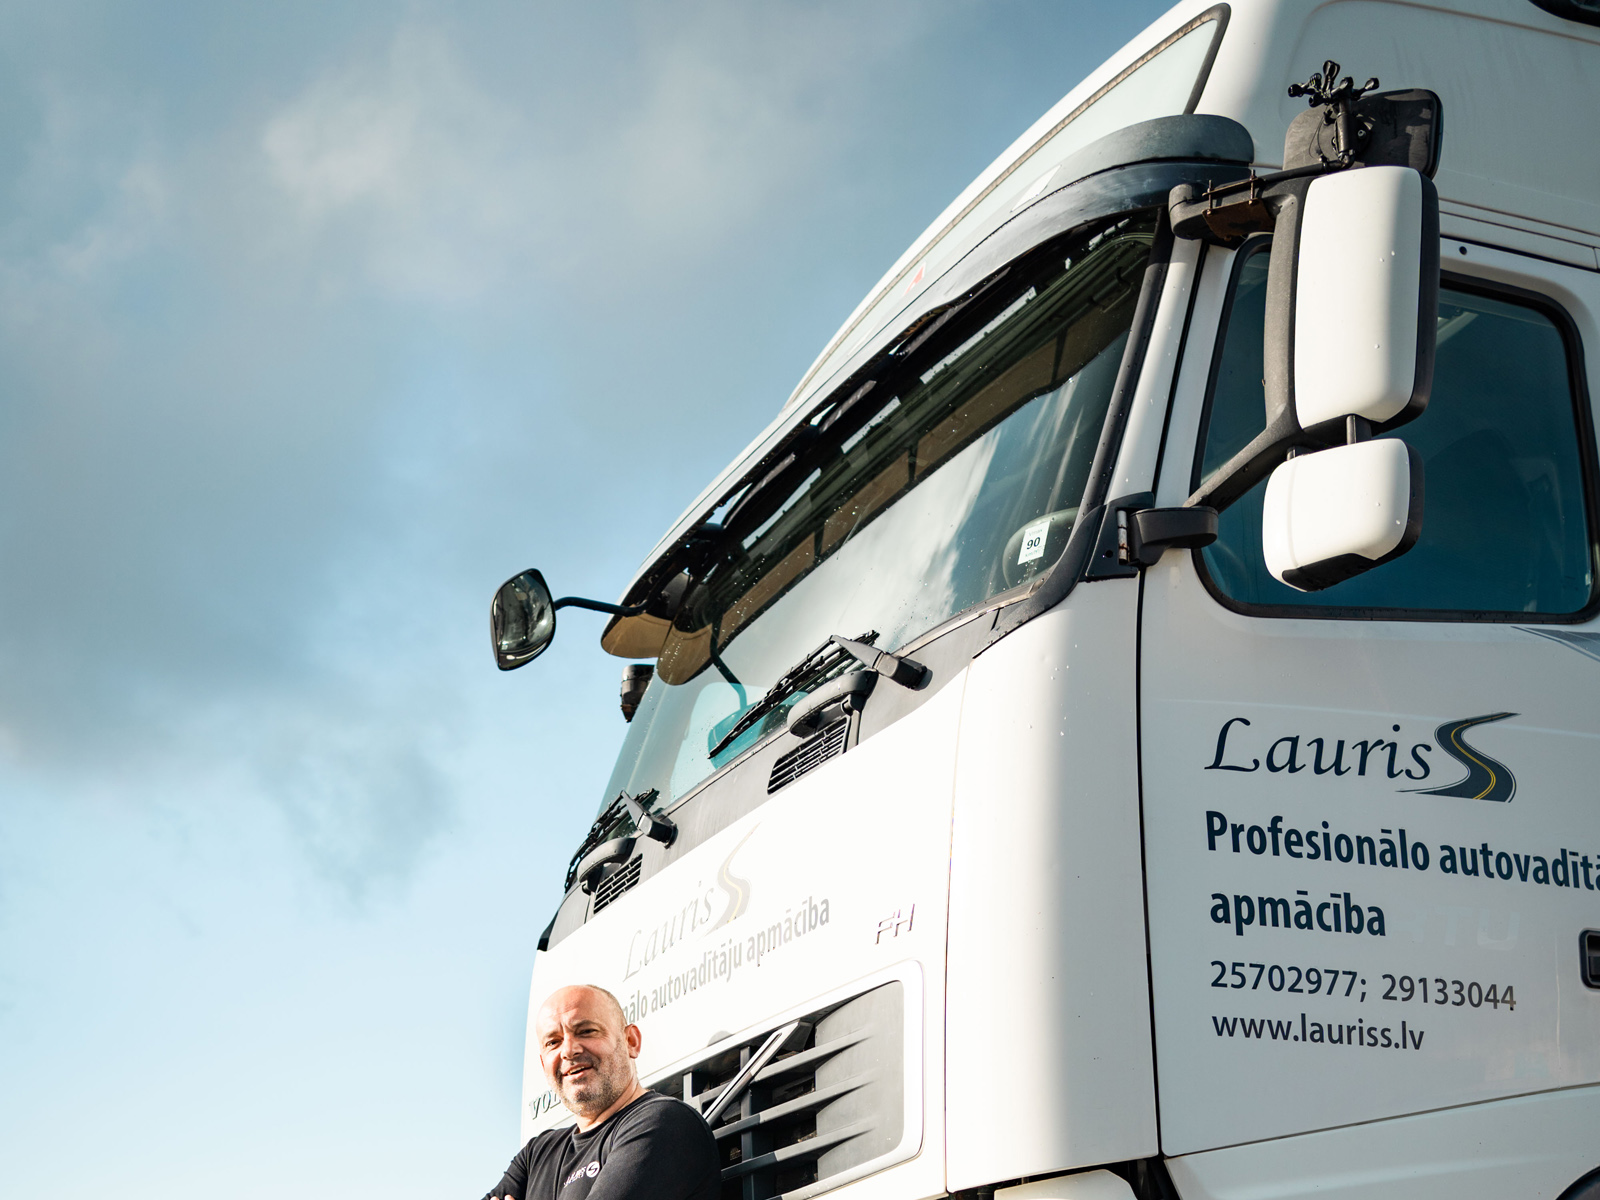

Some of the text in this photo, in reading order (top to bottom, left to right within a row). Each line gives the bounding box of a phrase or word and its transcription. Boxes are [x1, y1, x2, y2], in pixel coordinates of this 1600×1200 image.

[1026, 537, 1041, 550] 90
[1206, 811, 1430, 872] Profesionālo
[875, 903, 916, 945] FH
[1211, 890, 1387, 937] apmācība
[651, 938, 742, 1013] autovadītāju
[747, 895, 830, 967] apmācība
[1211, 961, 1517, 1012] 25702977; 29133044
[1212, 1013, 1426, 1051] www.lauriss.lv
[529, 1089, 562, 1120] VOL
